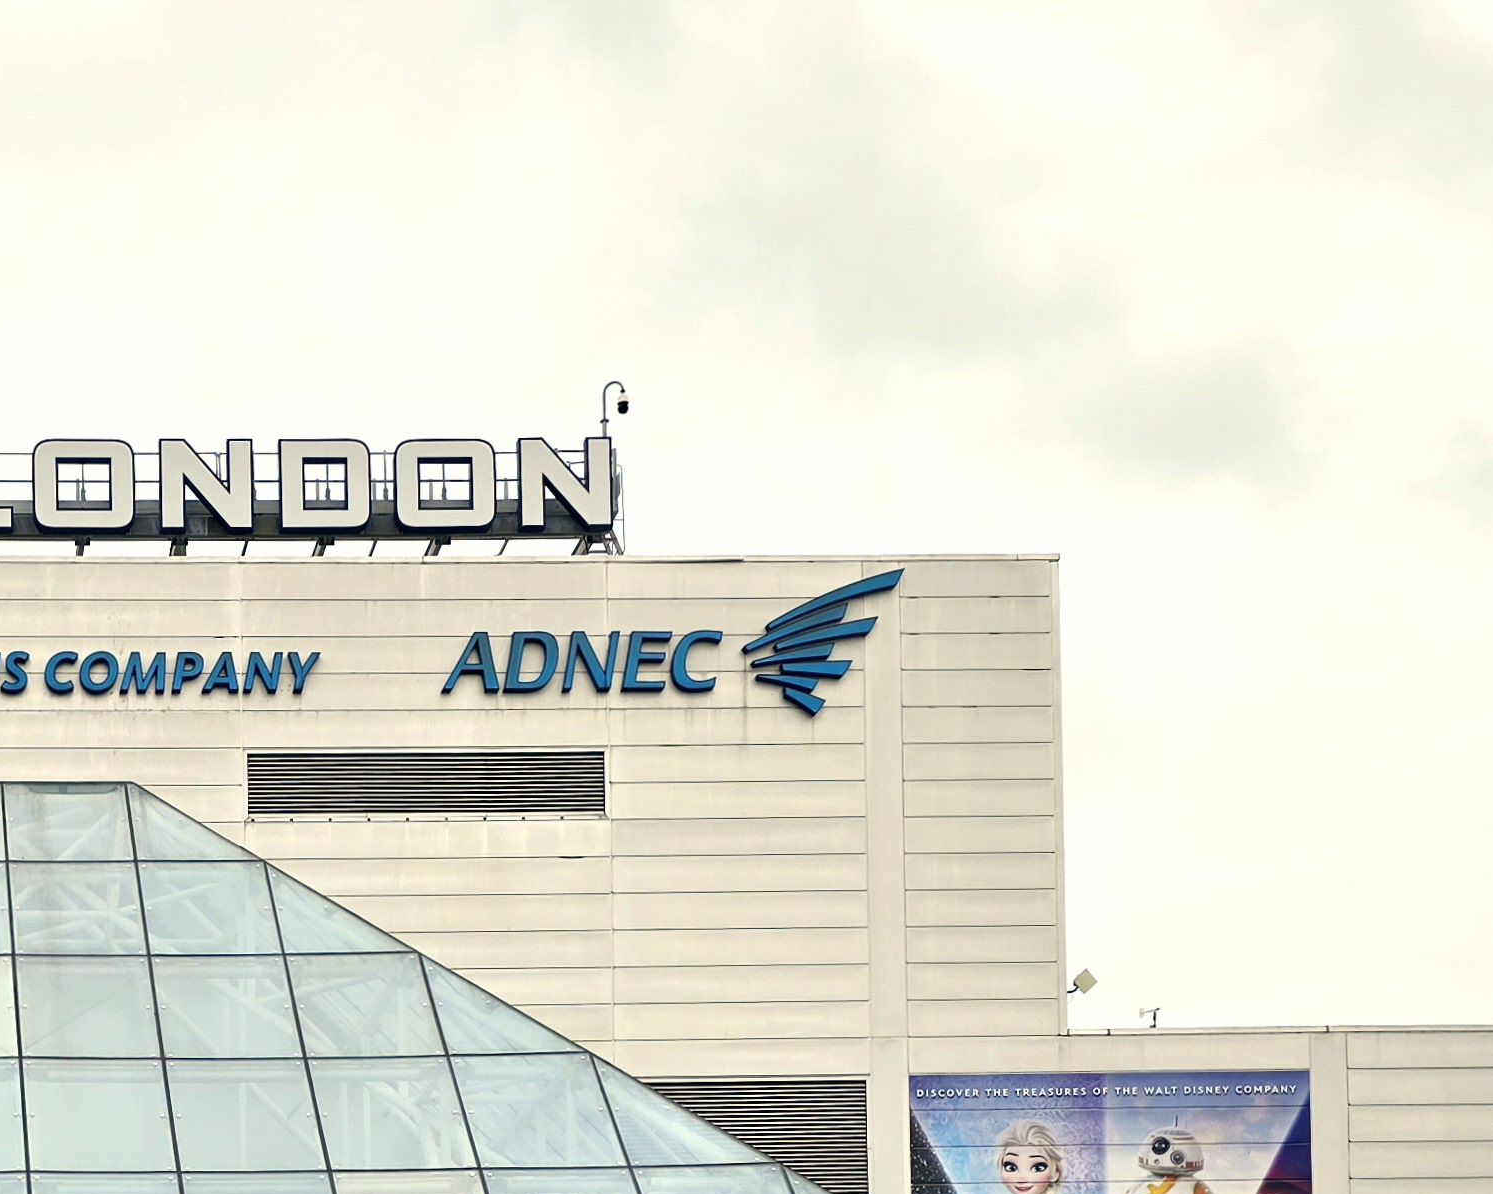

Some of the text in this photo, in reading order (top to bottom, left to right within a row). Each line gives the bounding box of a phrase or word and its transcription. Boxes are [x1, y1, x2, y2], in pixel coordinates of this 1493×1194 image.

[44, 650, 322, 696] COMPANY
[441, 630, 723, 694] ADNEC
[916, 1084, 1297, 1098] DISCOVER THE TREASURES OF THE WALT DISNEY COMPANY
